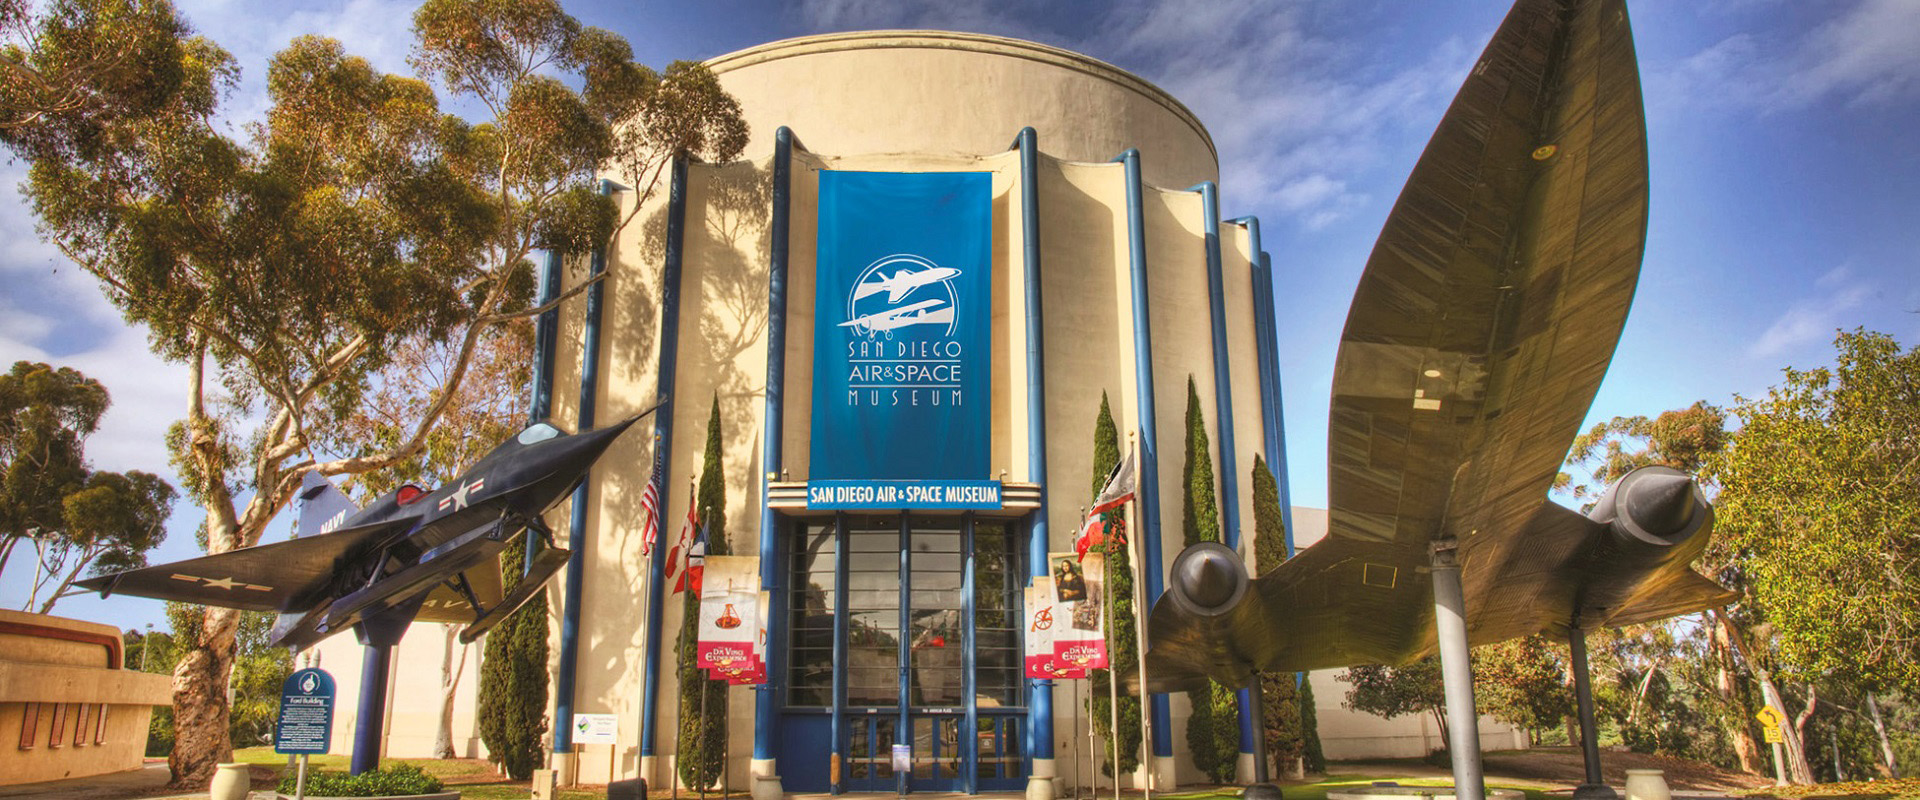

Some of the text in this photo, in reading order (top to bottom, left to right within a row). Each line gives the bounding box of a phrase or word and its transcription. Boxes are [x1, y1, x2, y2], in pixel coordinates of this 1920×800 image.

[848, 341, 962, 357] SAN DIEGO
[848, 390, 962, 406] MUSEUM
[810, 486, 998, 503] SAN DIEGO AIR & SPACE MUSEUM
[320, 508, 347, 534] NAVY
